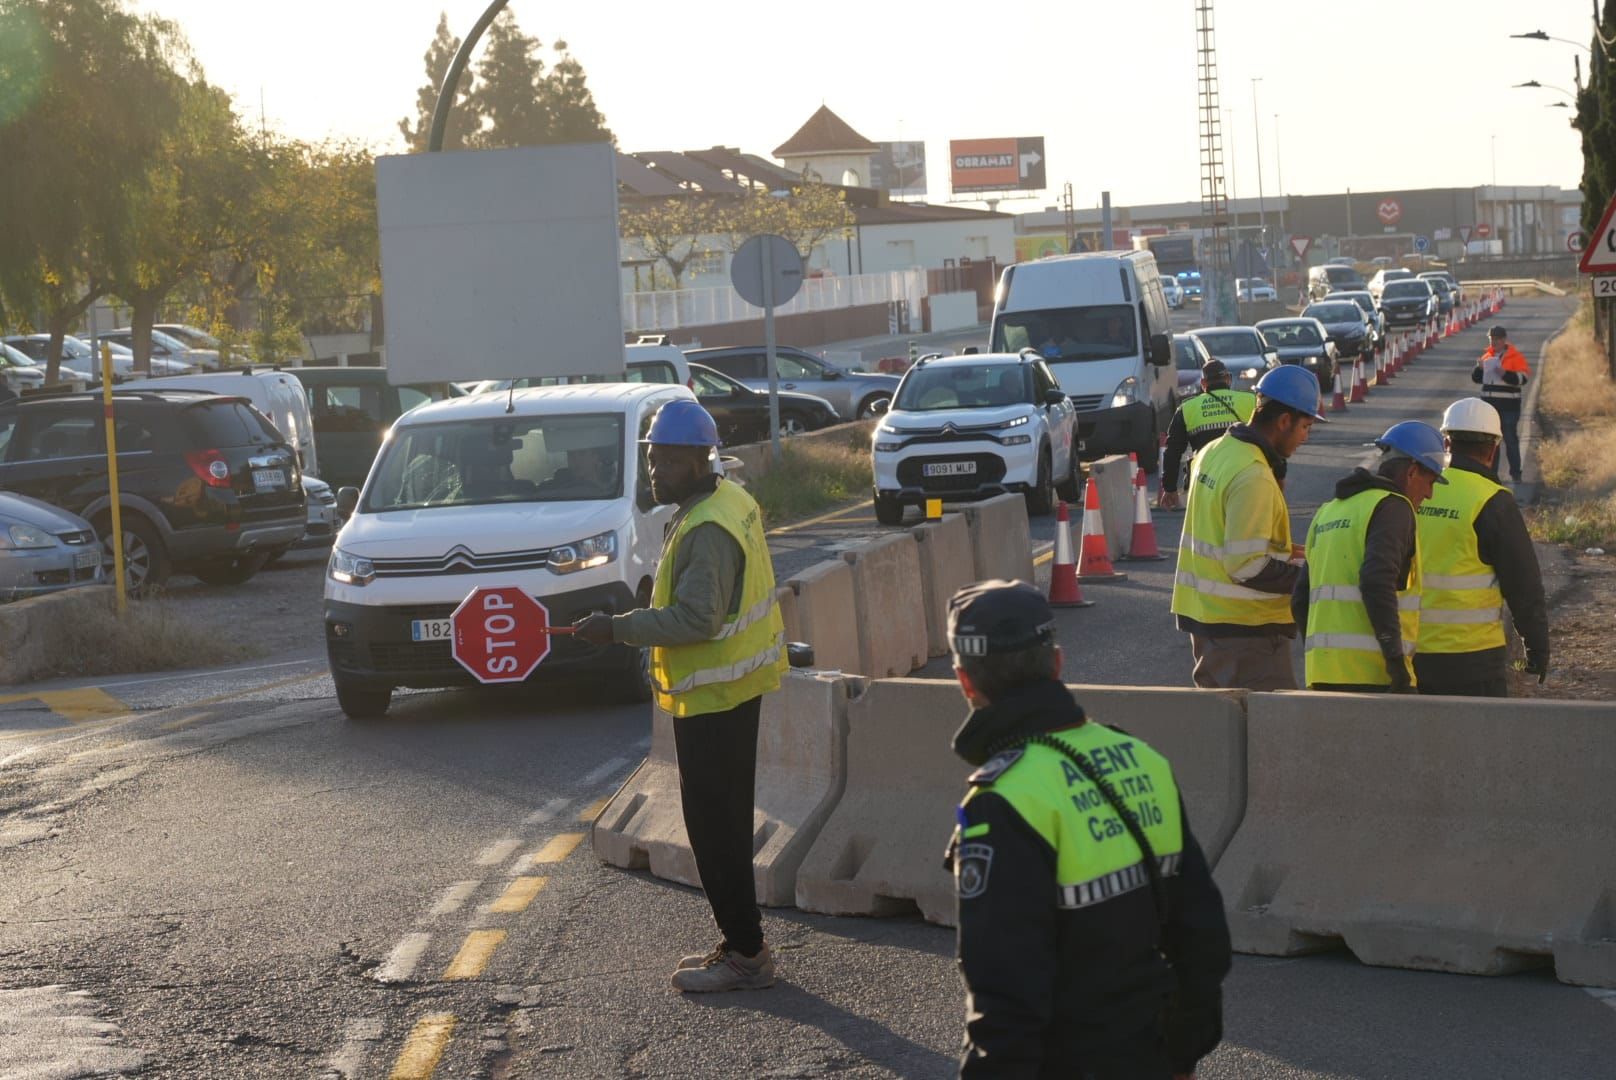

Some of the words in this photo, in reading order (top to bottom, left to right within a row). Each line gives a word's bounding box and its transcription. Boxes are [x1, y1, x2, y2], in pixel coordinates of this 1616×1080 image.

[955, 155, 1014, 168] OBRAMAT
[929, 464, 953, 475] 9091
[956, 463, 974, 473] MLP
[484, 594, 518, 673] STOP
[1060, 742, 1140, 788] AENT
